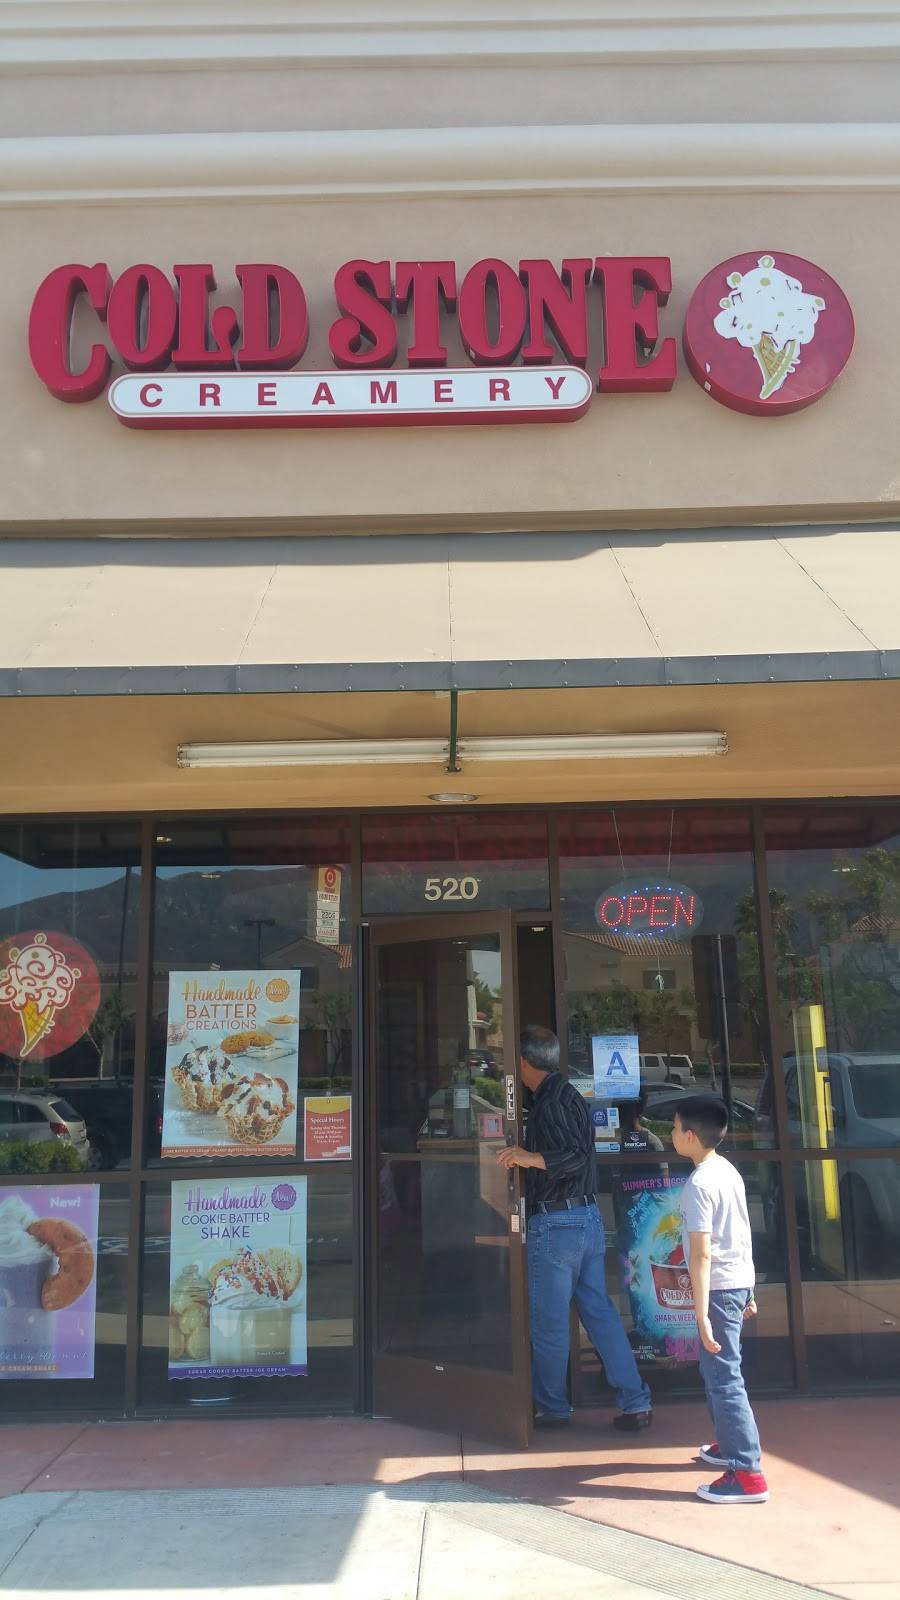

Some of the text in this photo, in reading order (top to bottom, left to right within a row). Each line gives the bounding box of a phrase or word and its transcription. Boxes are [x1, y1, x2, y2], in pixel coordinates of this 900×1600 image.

[28, 256, 677, 396] COLD STONE
[139, 376, 567, 408] CREAMERY
[424, 876, 479, 901] 520
[600, 895, 695, 927] OPEN
[182, 978, 262, 1002] Handmade
[186, 1003, 257, 1019] BATTER
[186, 1019, 257, 1031] CREATIONS
[606, 1051, 630, 1076] A
[622, 1177, 687, 1192] SUMMER'S BIGGE
[50, 1196, 81, 1209] New!
[183, 1184, 269, 1212] Handmade
[181, 1212, 270, 1226] COOKIE BATTER
[201, 1225, 251, 1240] SHAKE
[655, 1313, 677, 1322] SHARK
